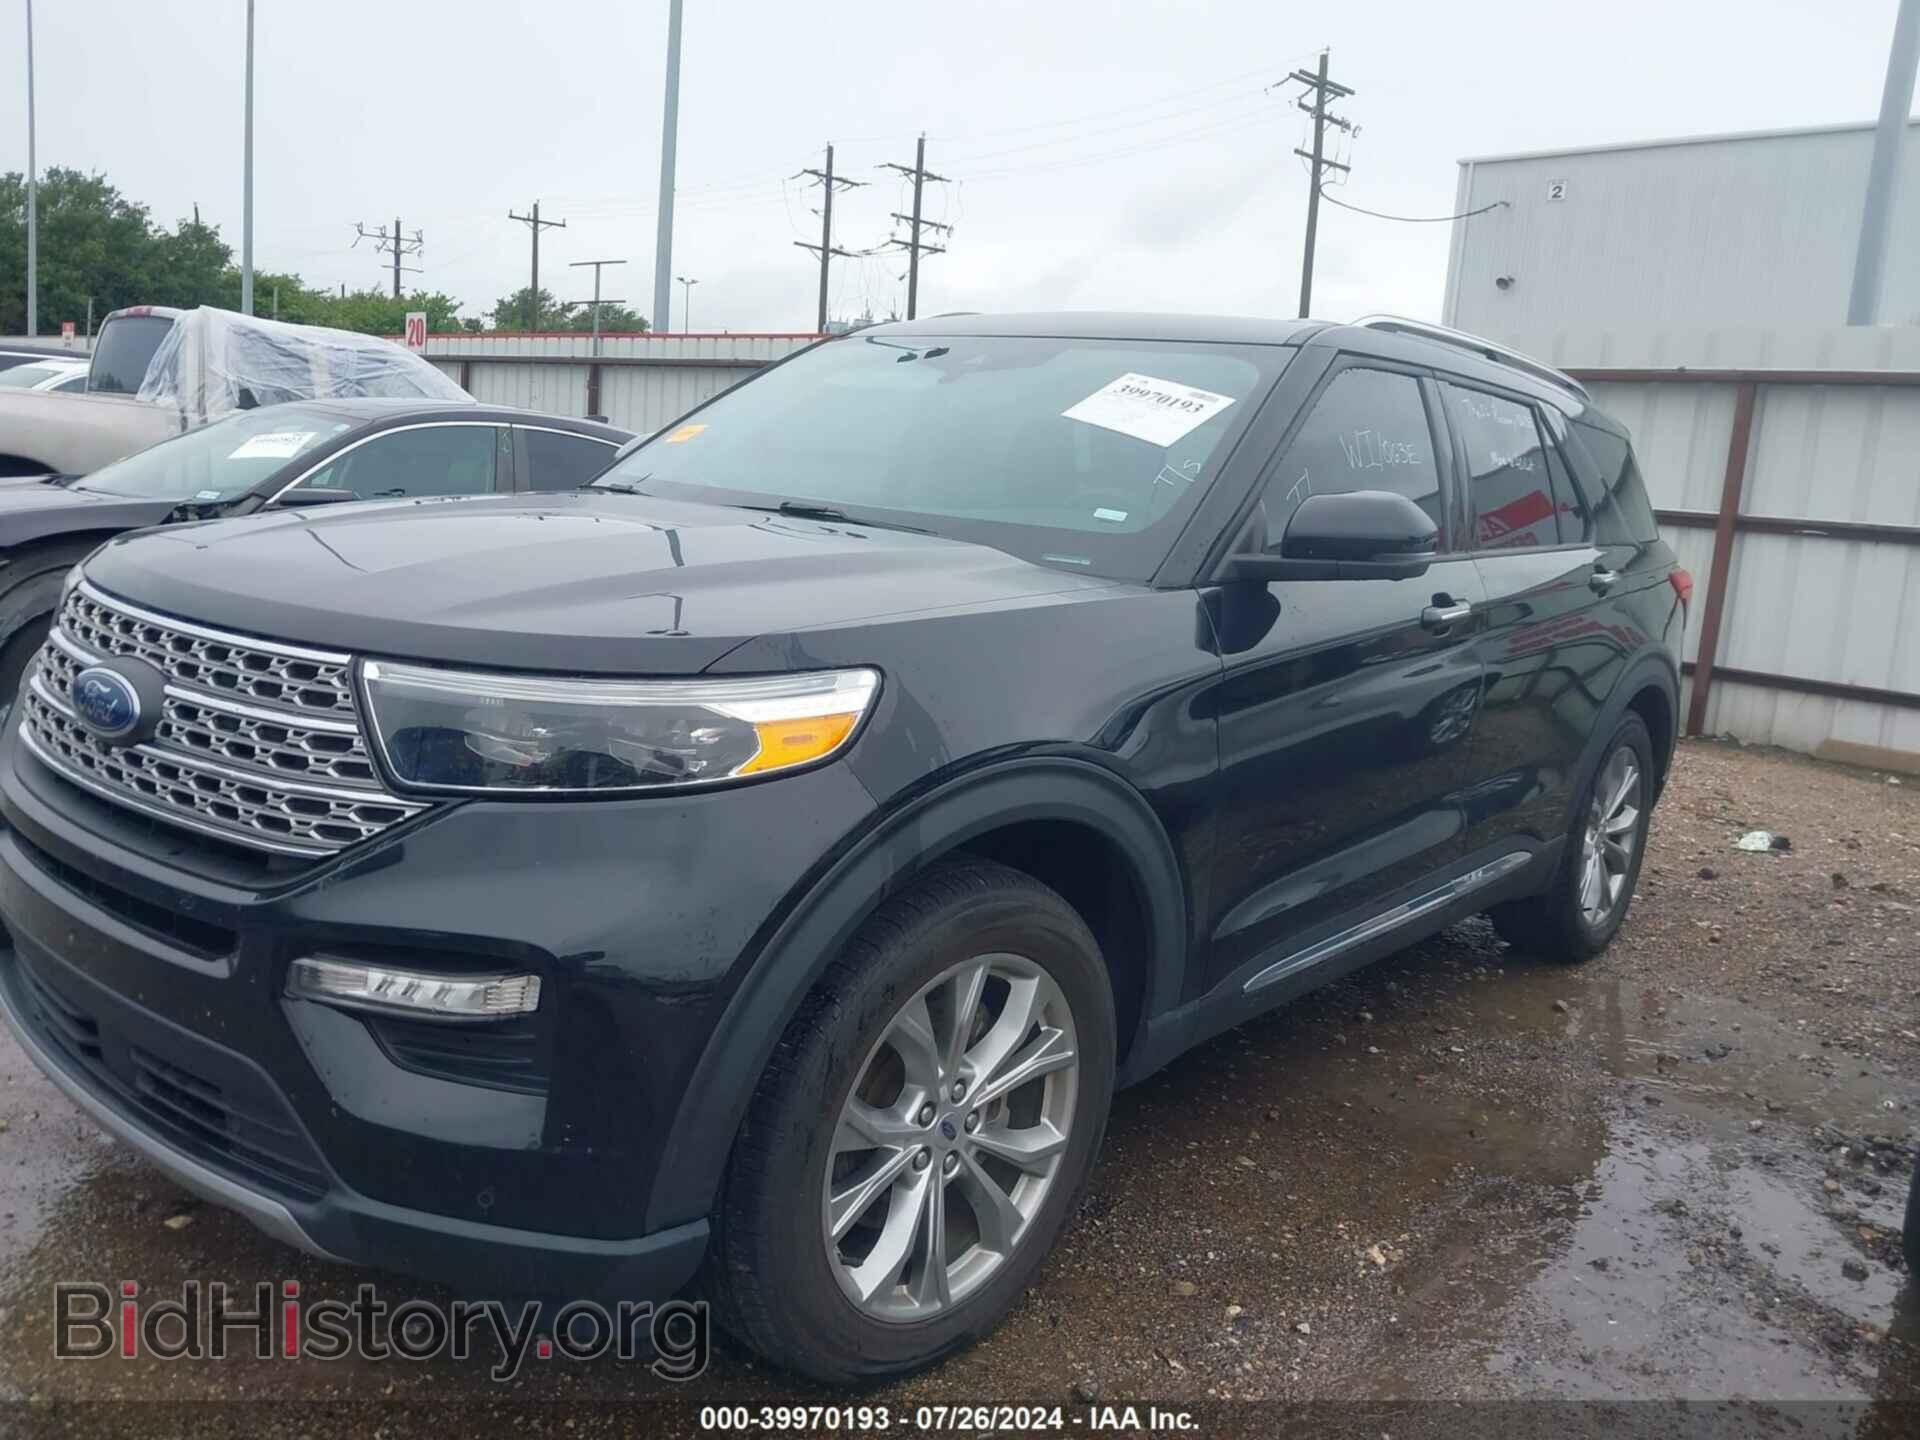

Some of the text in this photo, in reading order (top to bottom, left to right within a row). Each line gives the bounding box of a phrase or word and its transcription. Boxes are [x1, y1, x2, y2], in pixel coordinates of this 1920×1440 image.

[1551, 185, 1563, 199] 2
[408, 317, 425, 347] 20
[1113, 384, 1205, 414] 39970193
